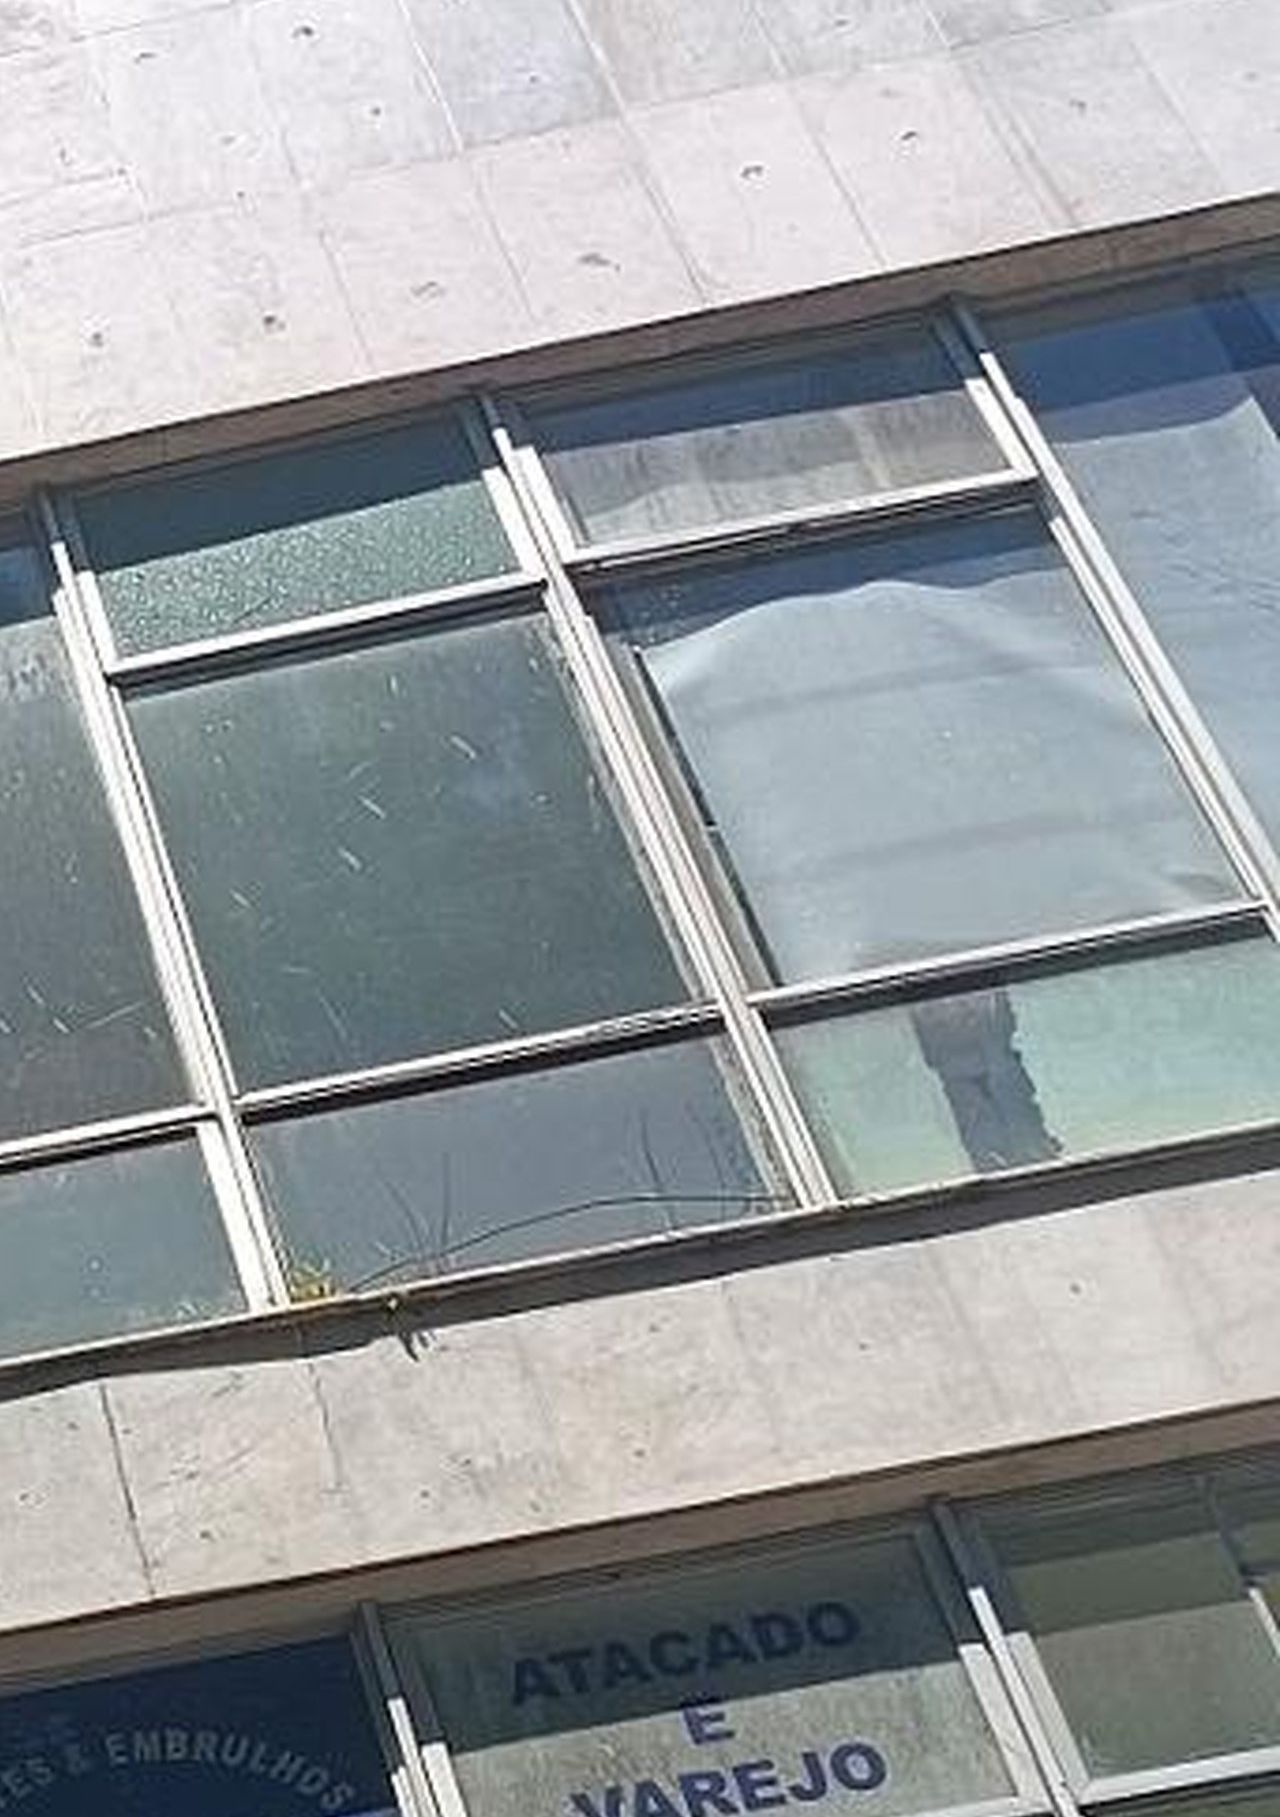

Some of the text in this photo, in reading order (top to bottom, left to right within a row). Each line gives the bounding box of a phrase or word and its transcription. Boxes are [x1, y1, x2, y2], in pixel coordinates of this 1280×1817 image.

[510, 1600, 863, 1706] ATACADO
[679, 1696, 735, 1746] E
[105, 1727, 355, 1811] EMBRULHOS
